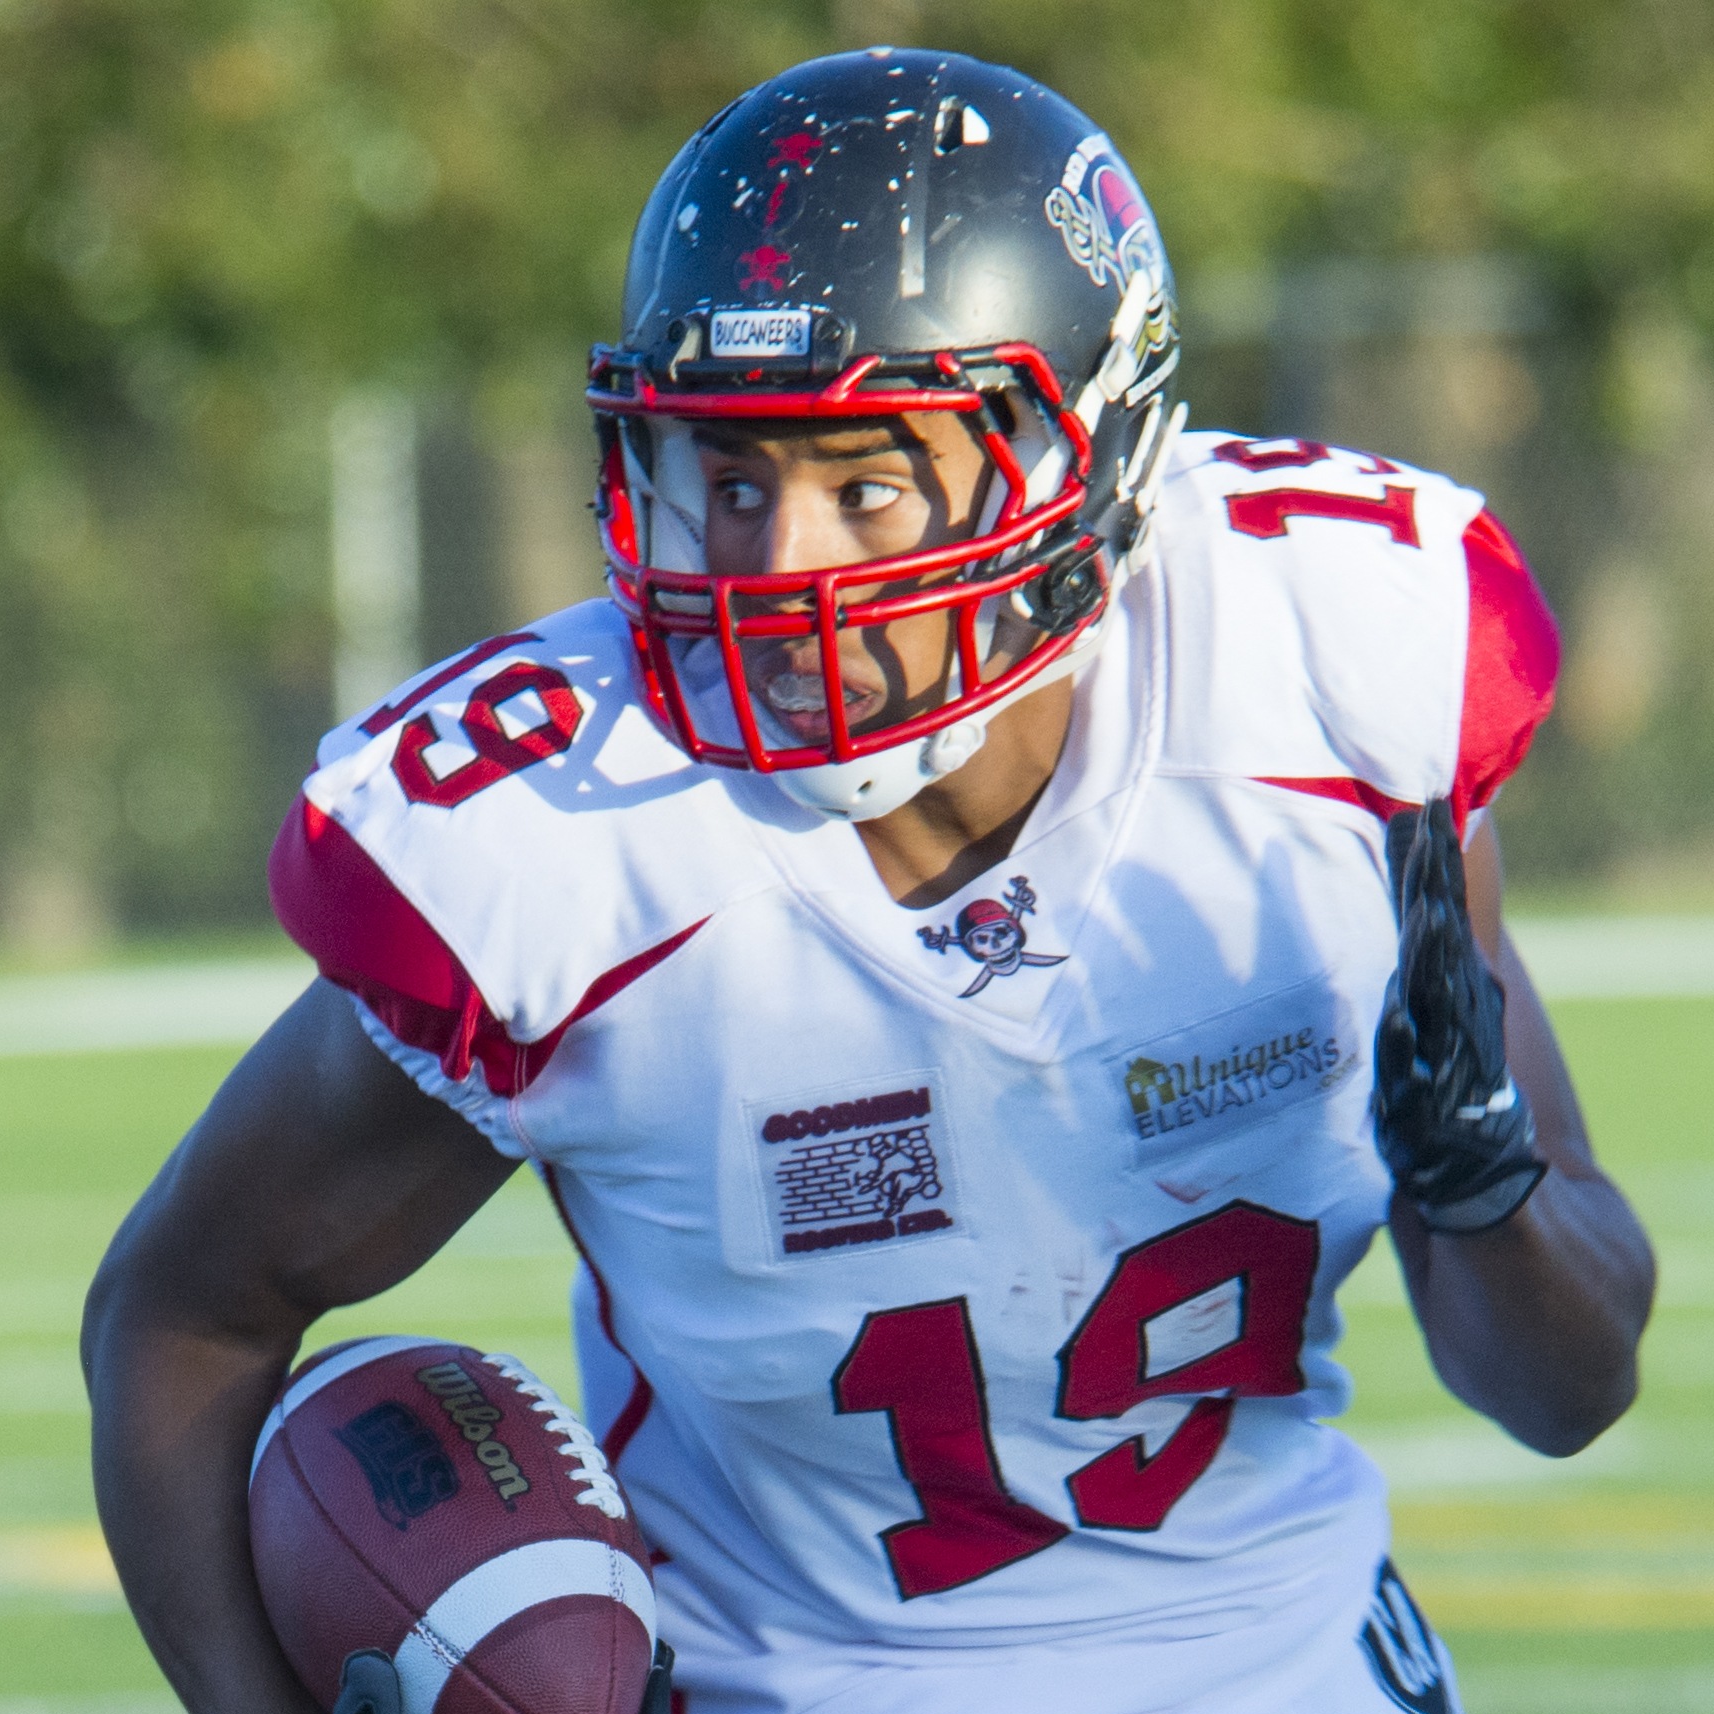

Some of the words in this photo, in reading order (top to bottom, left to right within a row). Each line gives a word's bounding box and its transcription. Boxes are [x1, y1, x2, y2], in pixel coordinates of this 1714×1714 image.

[714, 317, 804, 347] BUCCANEERS
[1135, 1037, 1341, 1140] ELEVATIONS
[1167, 1026, 1315, 1097] Unique
[414, 1361, 531, 1502] Wilson
[830, 1198, 1320, 1602] 19
